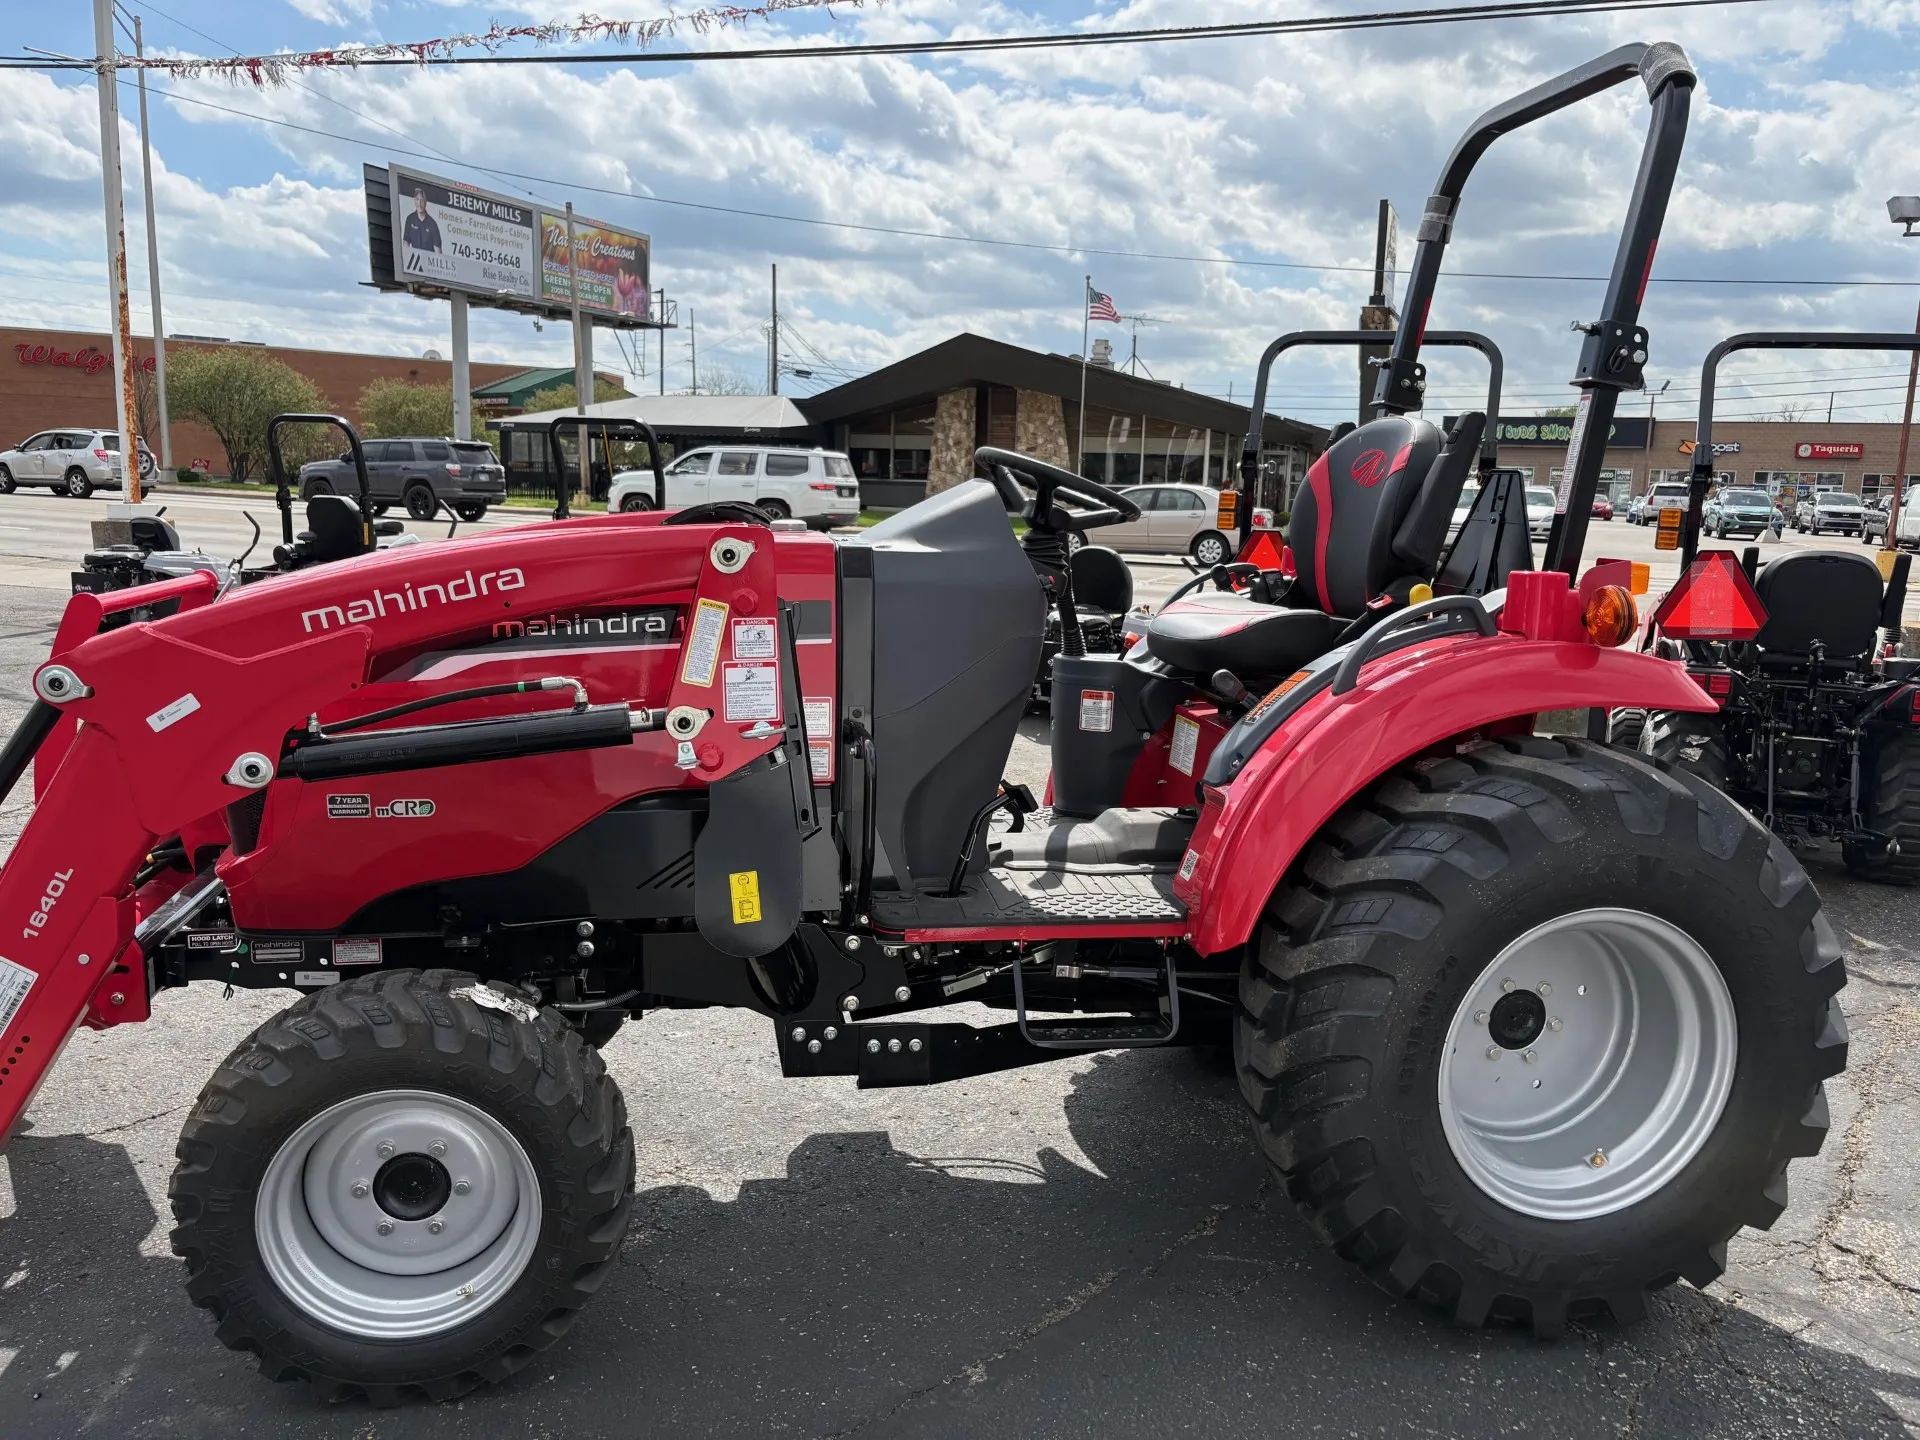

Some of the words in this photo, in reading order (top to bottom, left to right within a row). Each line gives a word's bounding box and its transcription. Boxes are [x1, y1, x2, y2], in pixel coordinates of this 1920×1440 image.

[448, 192, 490, 214] JEREMY
[492, 203, 521, 223] MILLS
[438, 210, 463, 224] Homes
[509, 228, 530, 241] Cabins
[447, 223, 489, 242] Commercial
[490, 233, 524, 250] Properties
[546, 226, 590, 251] Natral
[591, 236, 636, 261] Creations
[427, 256, 456, 272] MILLS
[451, 242, 521, 269] 740-503-6648
[482, 267, 497, 279] Rise
[498, 271, 518, 288] Realty
[519, 275, 530, 287] Co.
[543, 261, 569, 274] SPRING
[575, 268, 596, 280] TARTS
[593, 285, 612, 296] OPEN
[1505, 424, 1537, 440] BUDZ
[1540, 423, 1572, 441] SMOK
[1813, 444, 1859, 454] Taqueria
[301, 567, 526, 633] mahindra
[492, 612, 666, 638] mahindra
[334, 796, 341, 804] 7
[342, 796, 362, 804] YEAR
[23, 868, 75, 939] 1640L
[254, 941, 300, 949] mahindra
